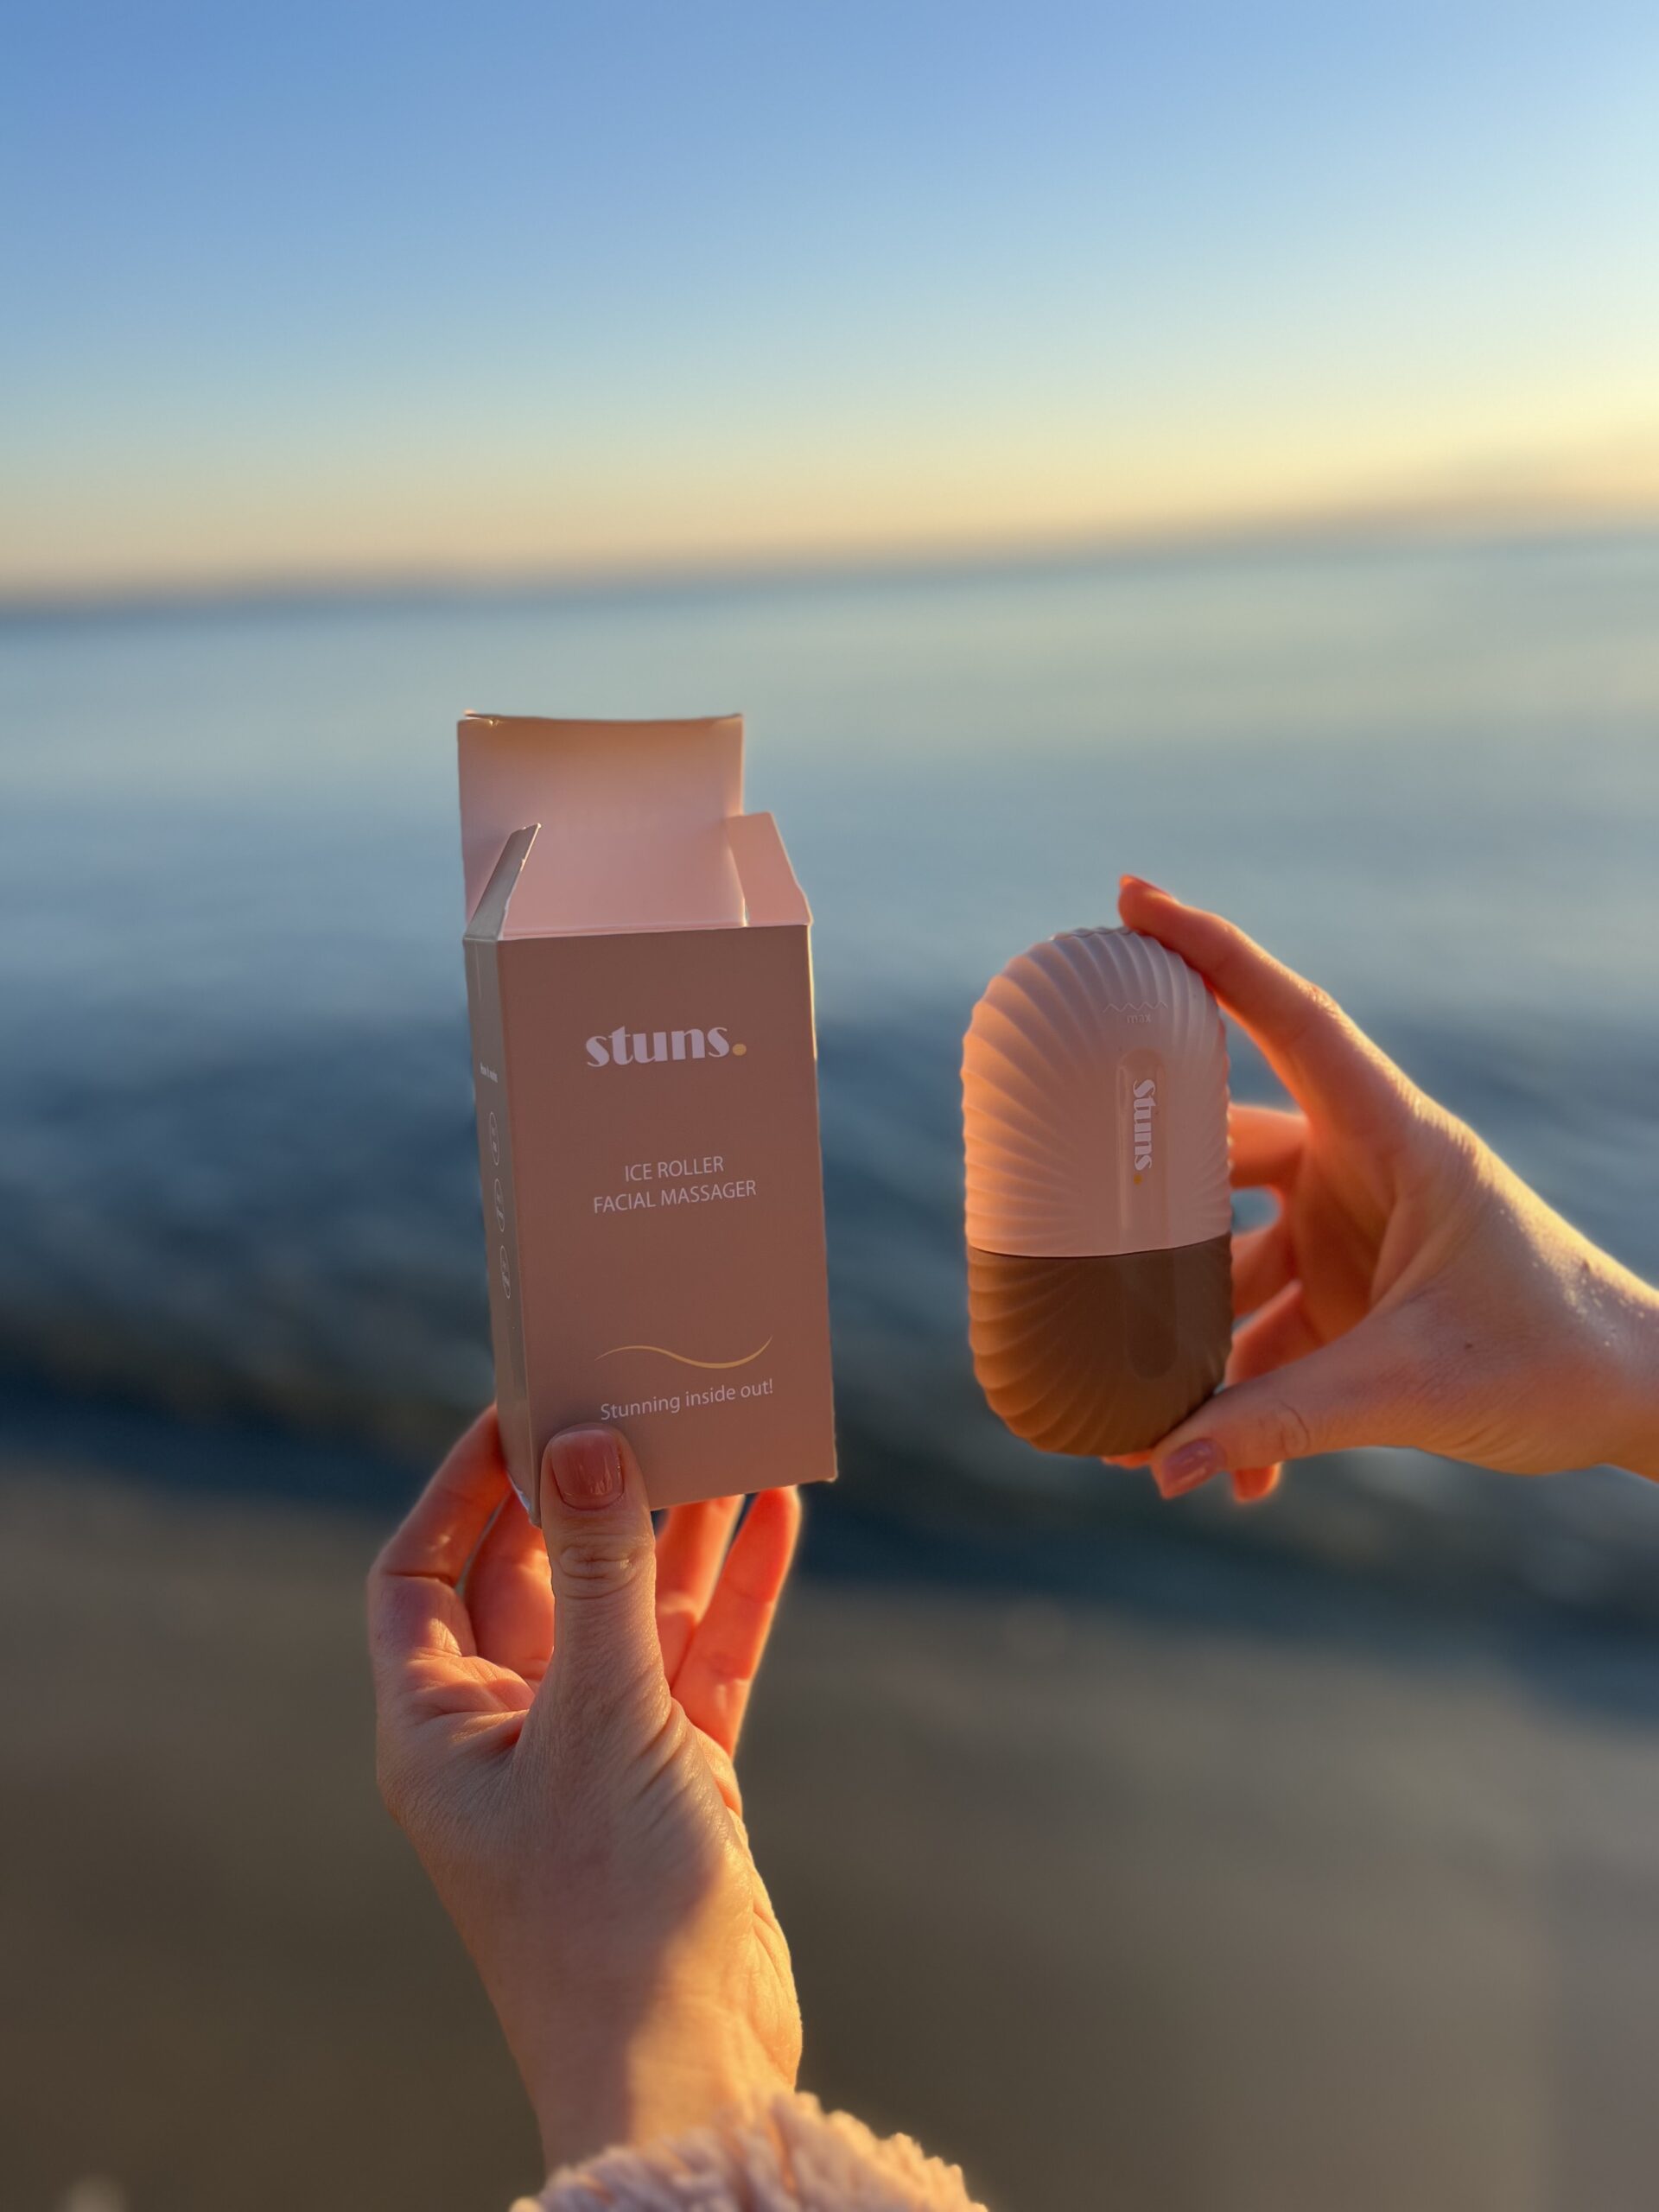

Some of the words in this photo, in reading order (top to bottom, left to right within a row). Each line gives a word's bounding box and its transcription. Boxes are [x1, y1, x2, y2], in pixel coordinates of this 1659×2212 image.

[1126, 1014, 1152, 1024] max
[625, 1163, 652, 1182] ICE
[658, 1155, 724, 1179] ROLLER
[594, 1192, 657, 1214] FACIAL
[661, 1179, 757, 1206] MASSAGER
[601, 1396, 681, 1421] Stunning
[685, 1384, 736, 1407] inside
[741, 1377, 774, 1398] out!
